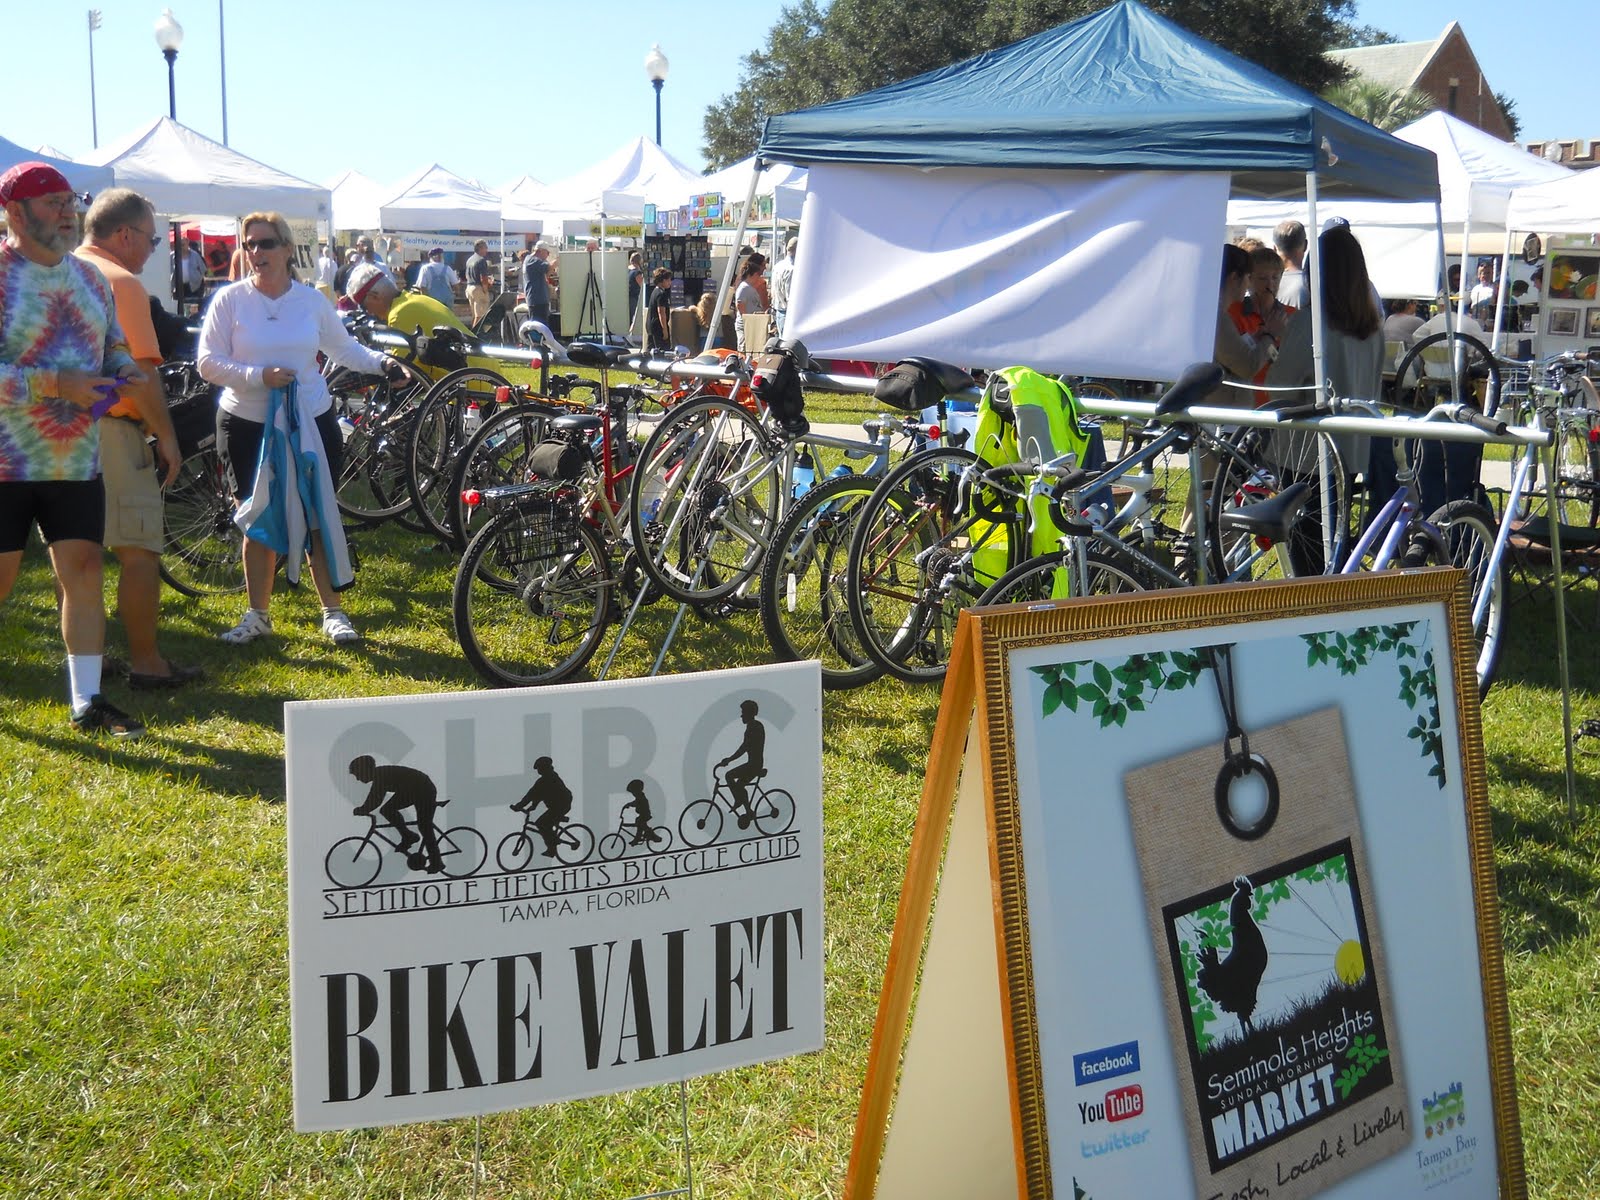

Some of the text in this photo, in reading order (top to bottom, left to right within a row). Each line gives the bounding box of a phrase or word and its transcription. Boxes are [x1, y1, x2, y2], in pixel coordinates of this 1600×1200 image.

[323, 834, 802, 917] SEMINOLE HEIGHTS BICYCLE CLUB
[498, 884, 671, 924] TAMPA, FLORIDA
[320, 908, 804, 1104] BIKE VALET
[1081, 1052, 1133, 1076] facebook
[1207, 1007, 1374, 1100] Seminole Heights
[1220, 1050, 1334, 1110] SUNDAY MORNING
[1080, 1128, 1151, 1159] twitter
[1210, 1062, 1336, 1160] MARKET
[1276, 1139, 1333, 1187] Local
[1336, 1135, 1347, 1159] &
[1353, 1106, 1405, 1146] Lively
[1416, 1135, 1477, 1169] Tampa Bay
